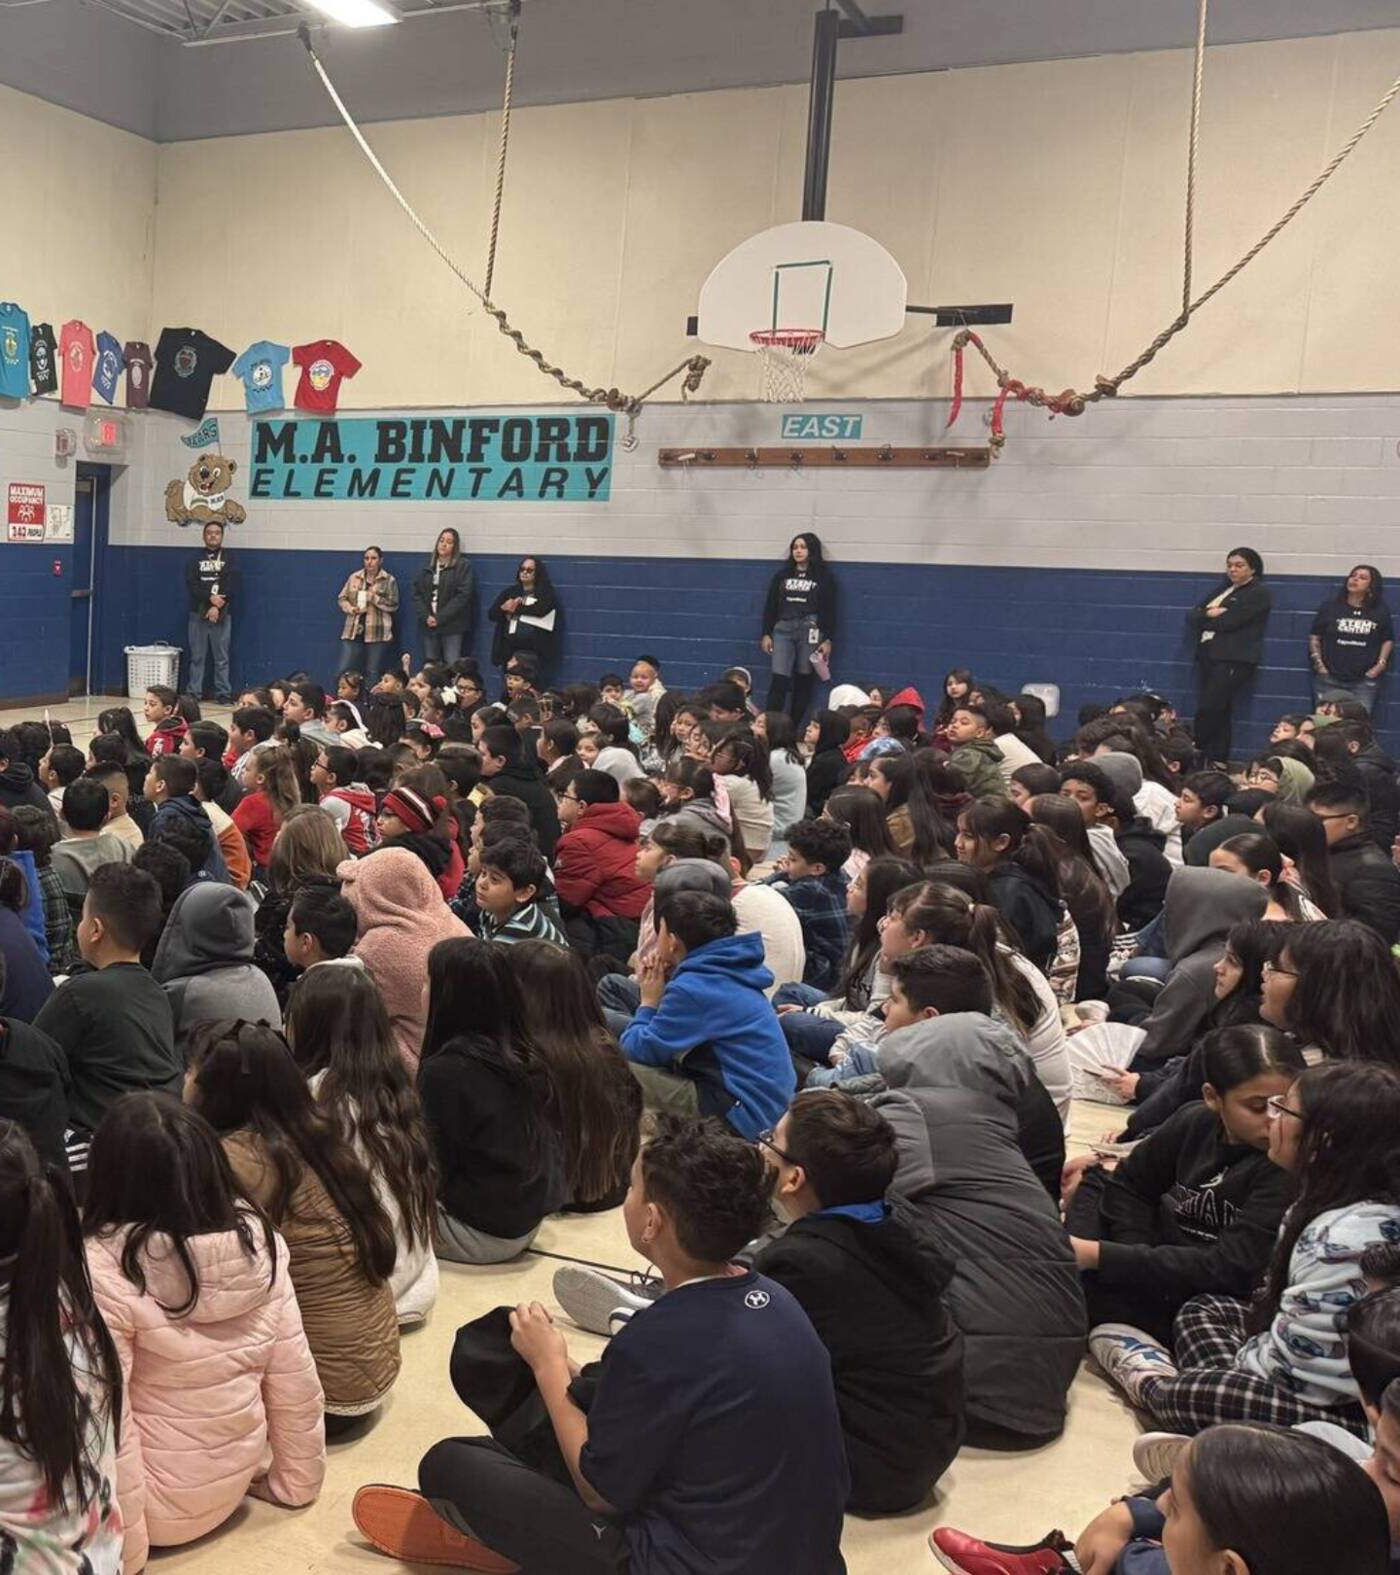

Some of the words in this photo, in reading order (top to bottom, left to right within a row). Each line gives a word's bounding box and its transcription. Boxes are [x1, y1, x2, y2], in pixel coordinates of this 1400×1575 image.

[255, 421, 357, 464] M.A.
[374, 418, 610, 463] BINFORD
[783, 415, 860, 437] EAST
[251, 467, 609, 498] ELEMENTARY
